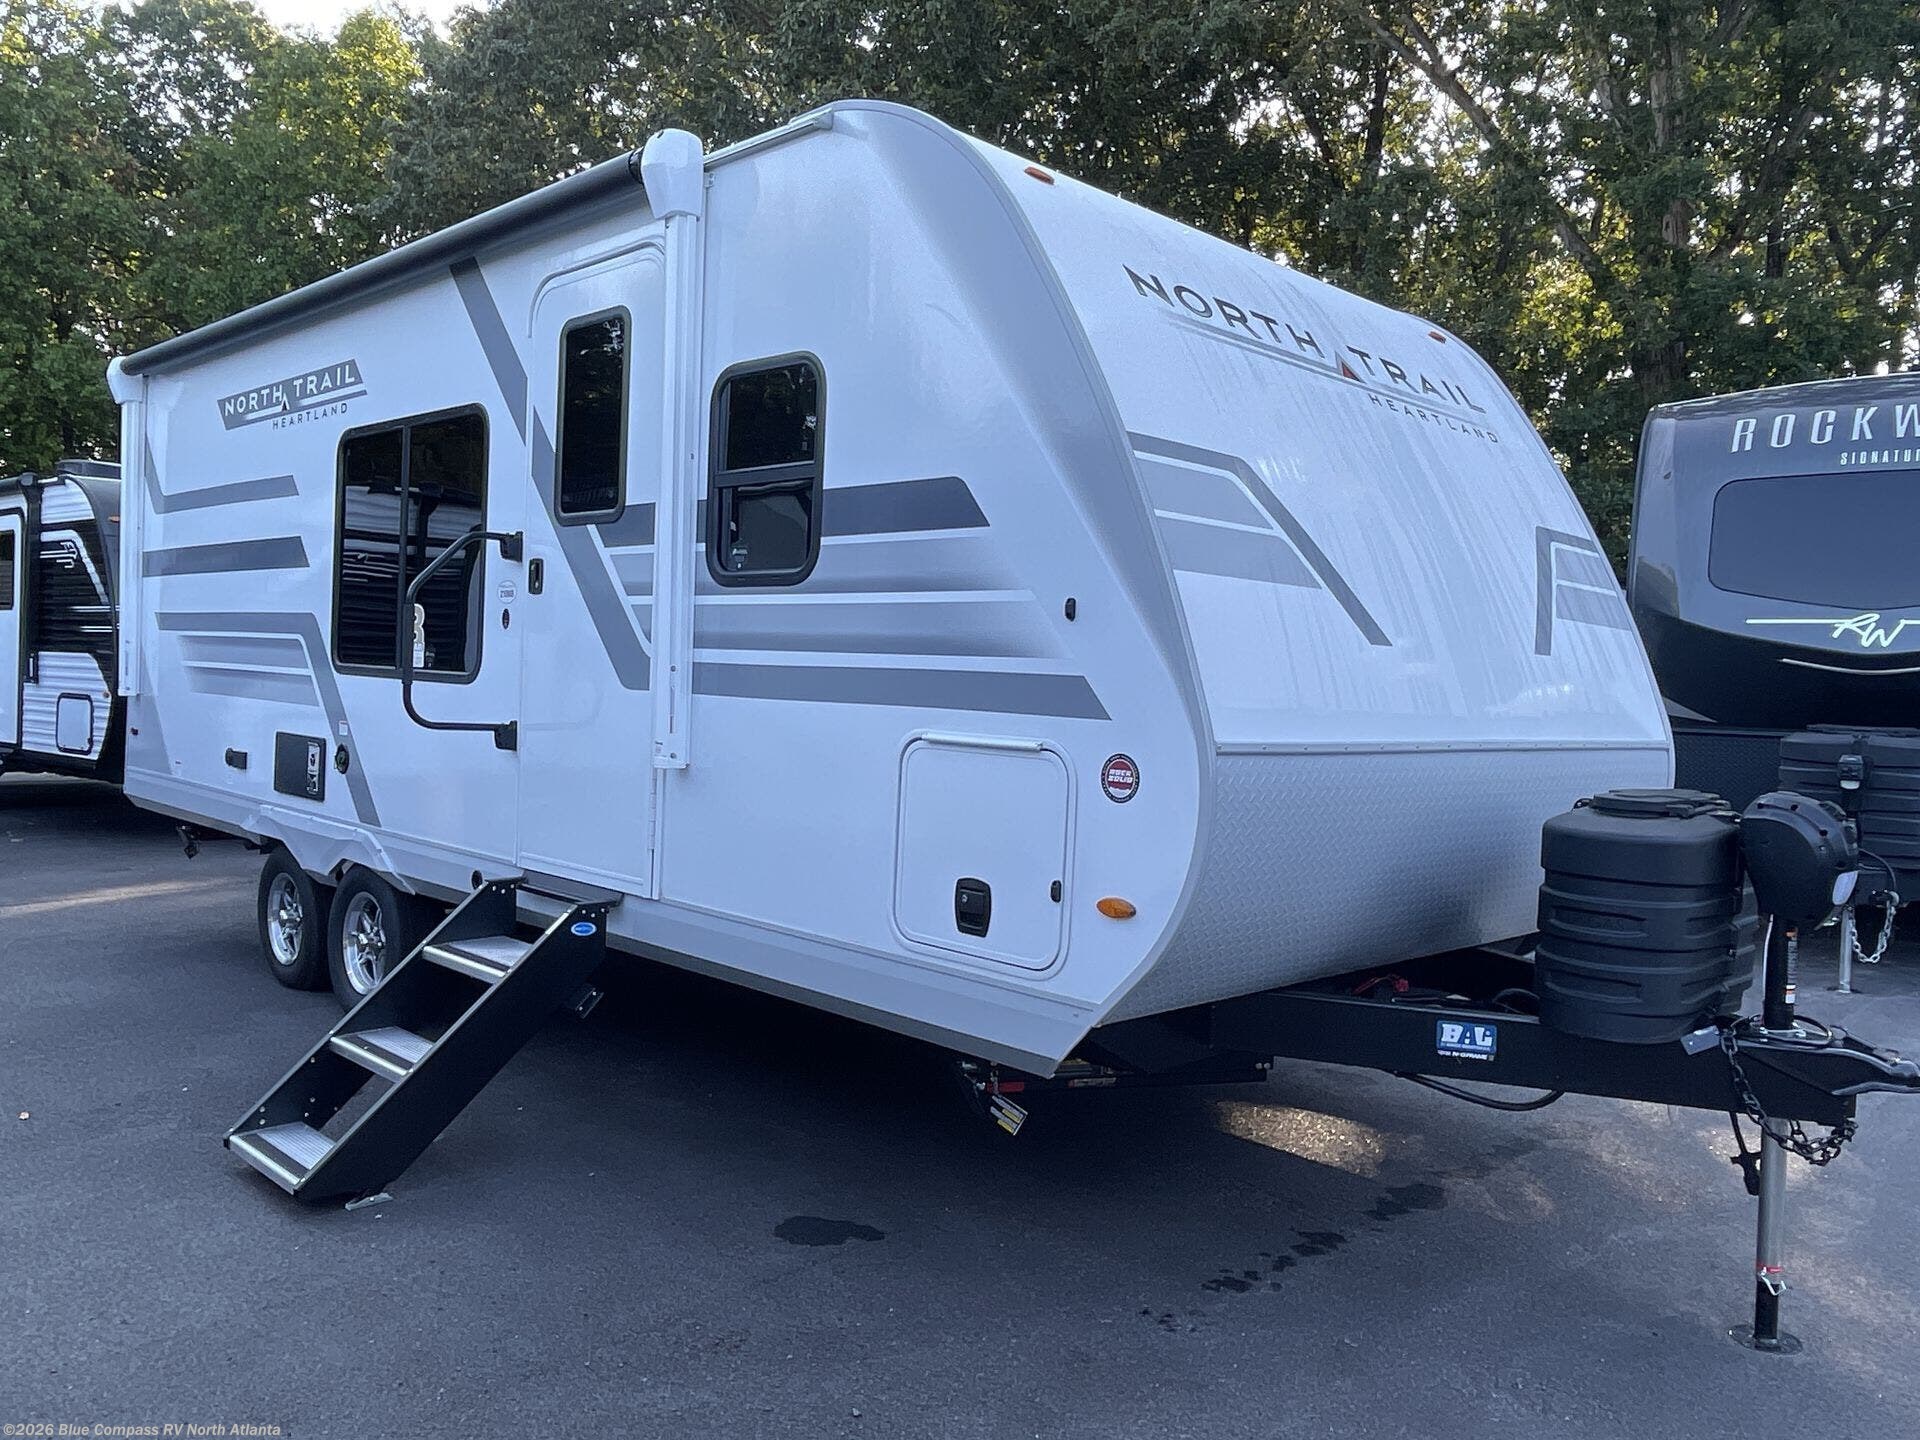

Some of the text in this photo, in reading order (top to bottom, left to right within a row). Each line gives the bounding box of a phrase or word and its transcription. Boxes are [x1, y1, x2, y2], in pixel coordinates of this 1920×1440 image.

[1122, 264, 1486, 413] NORTH TRAIL
[224, 364, 355, 416] NORTH TRAIL
[272, 402, 349, 430] HEARTLAND
[1369, 393, 1499, 443] HEARTLAND
[1731, 403, 1920, 453] ROCKW
